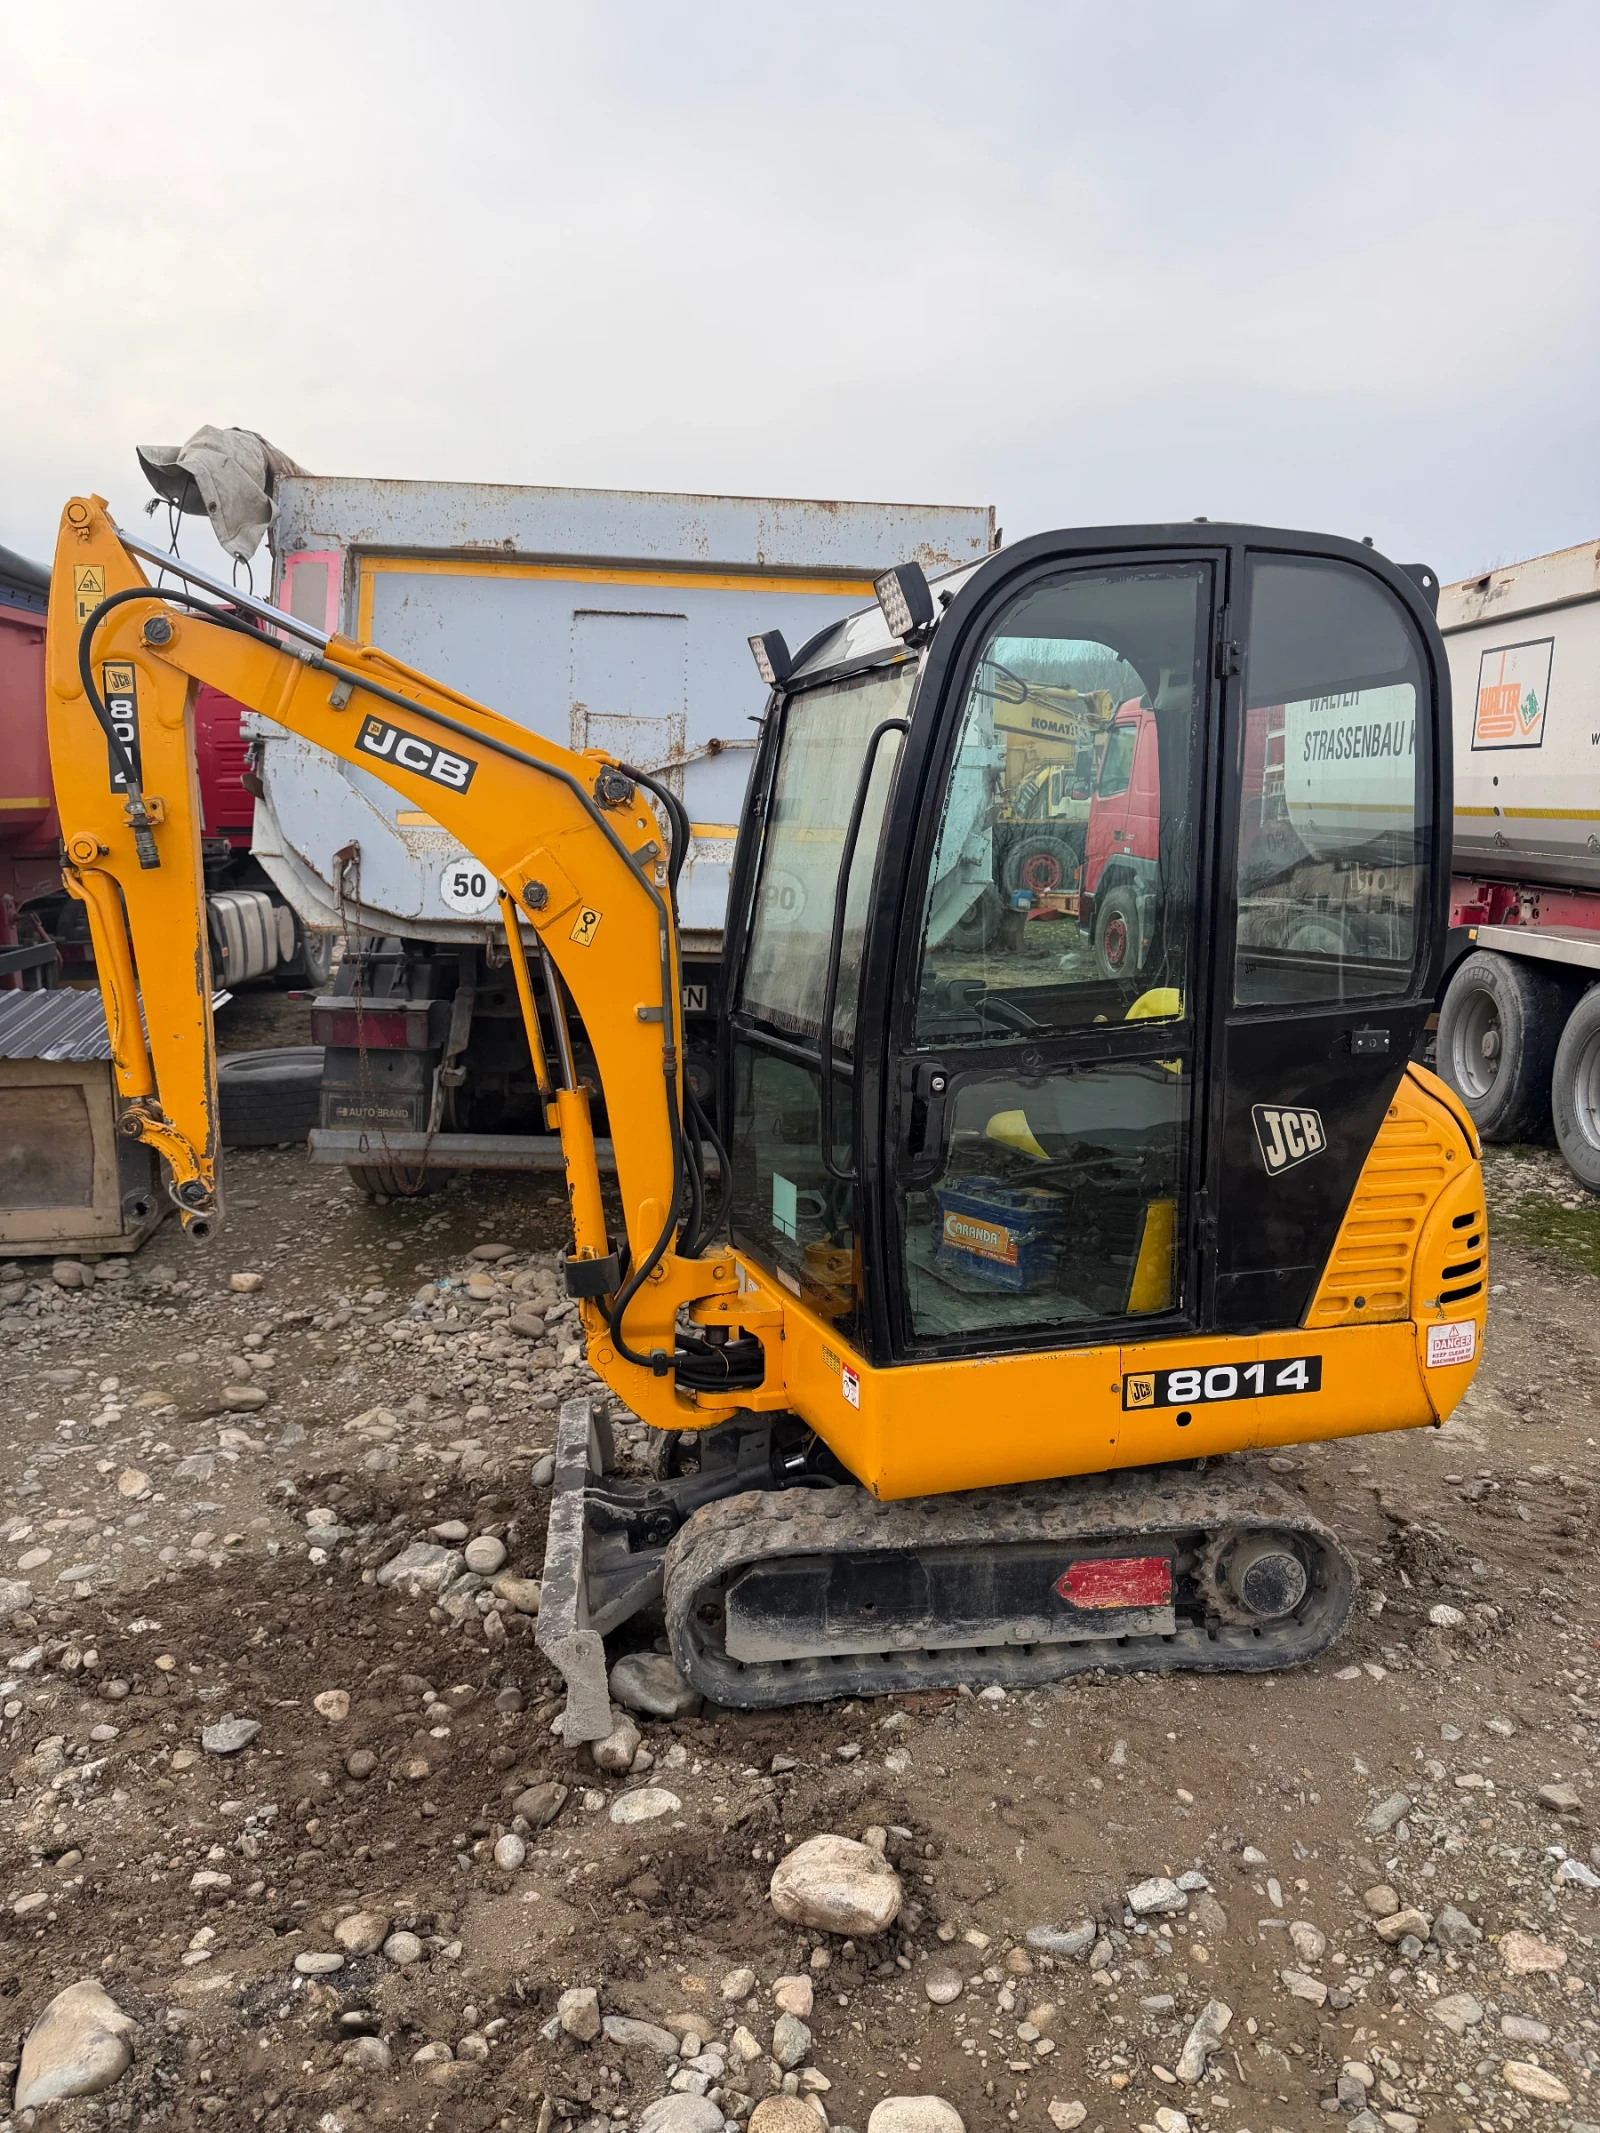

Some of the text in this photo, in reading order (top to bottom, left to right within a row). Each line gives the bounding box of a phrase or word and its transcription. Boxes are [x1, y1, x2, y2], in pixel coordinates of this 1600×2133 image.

[112, 673, 131, 688] JCB
[1303, 720, 1406, 762] STRASSENBAU
[363, 729, 470, 787] JCB
[453, 873, 487, 898] 50
[682, 987, 704, 1009] N
[349, 1107, 376, 1118] AUTO
[1263, 1111, 1322, 1168] JCB
[945, 1215, 998, 1246] CARANDA
[1434, 1335, 1472, 1350] DANGER
[1133, 1359, 1310, 1403] JCB 8014
